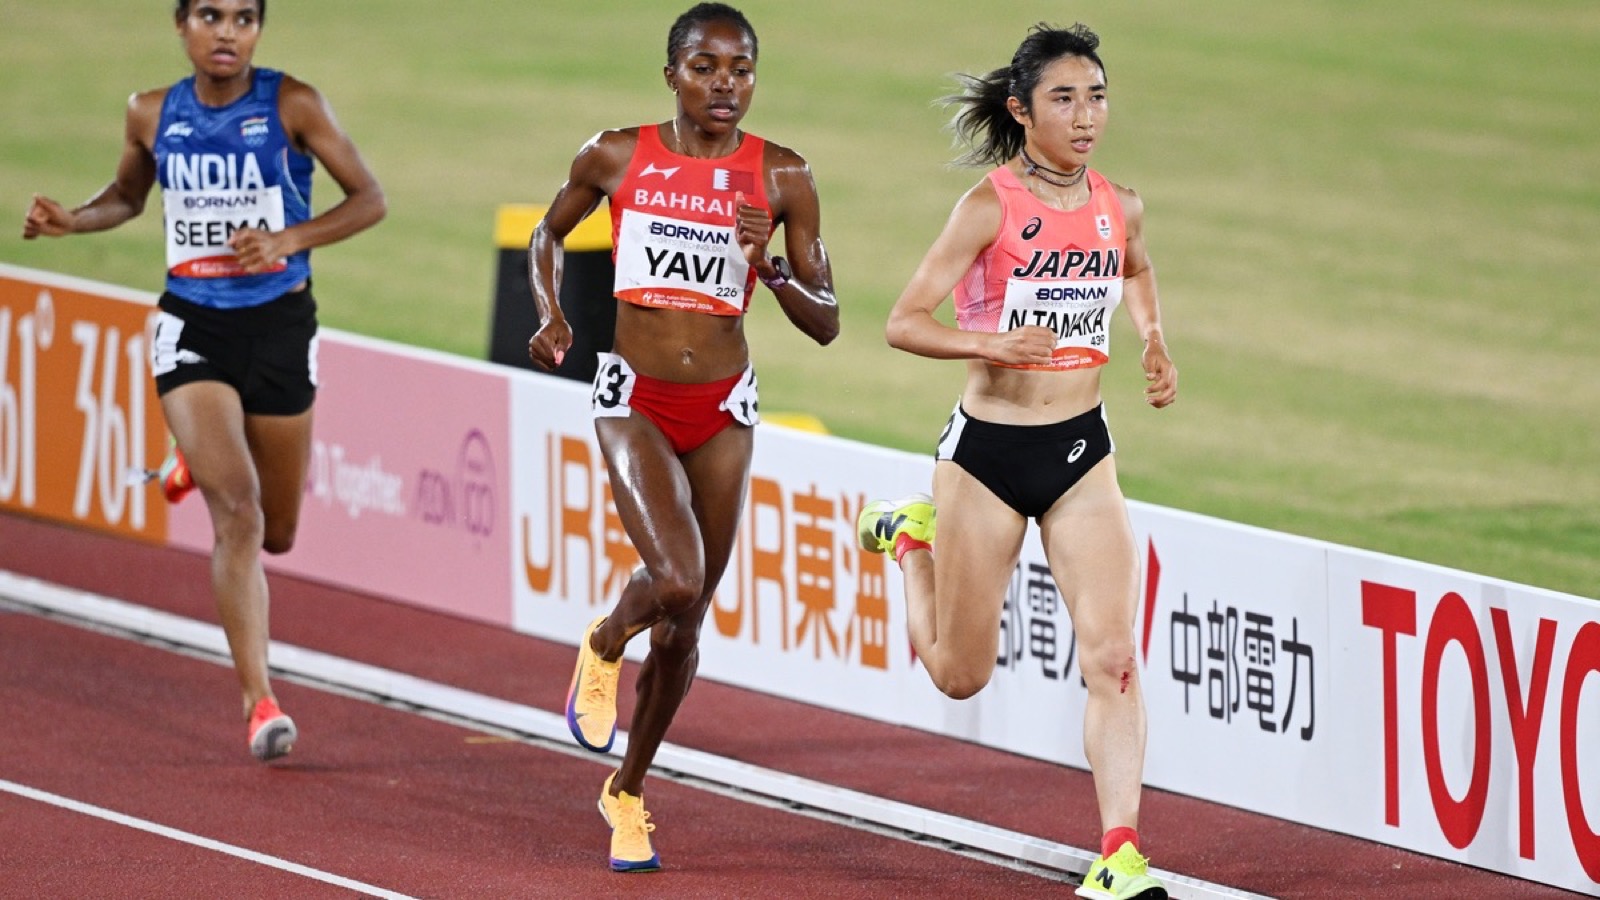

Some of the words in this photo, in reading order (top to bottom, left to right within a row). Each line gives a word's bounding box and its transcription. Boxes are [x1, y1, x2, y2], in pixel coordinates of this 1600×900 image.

[167, 152, 265, 191] INDIA
[184, 195, 257, 209] BORNAN
[634, 188, 733, 217] BAHRAI
[649, 221, 730, 245] BORNAN
[644, 246, 726, 285] YAVI
[1012, 249, 1120, 278] JAPAN
[715, 286, 738, 298] 226
[1034, 286, 1108, 301] BORNAN
[1090, 334, 1105, 346] 439
[71, 310, 156, 532] 361
[1171, 592, 1315, 741] 中部電力
[1361, 580, 1600, 884] TOYO
